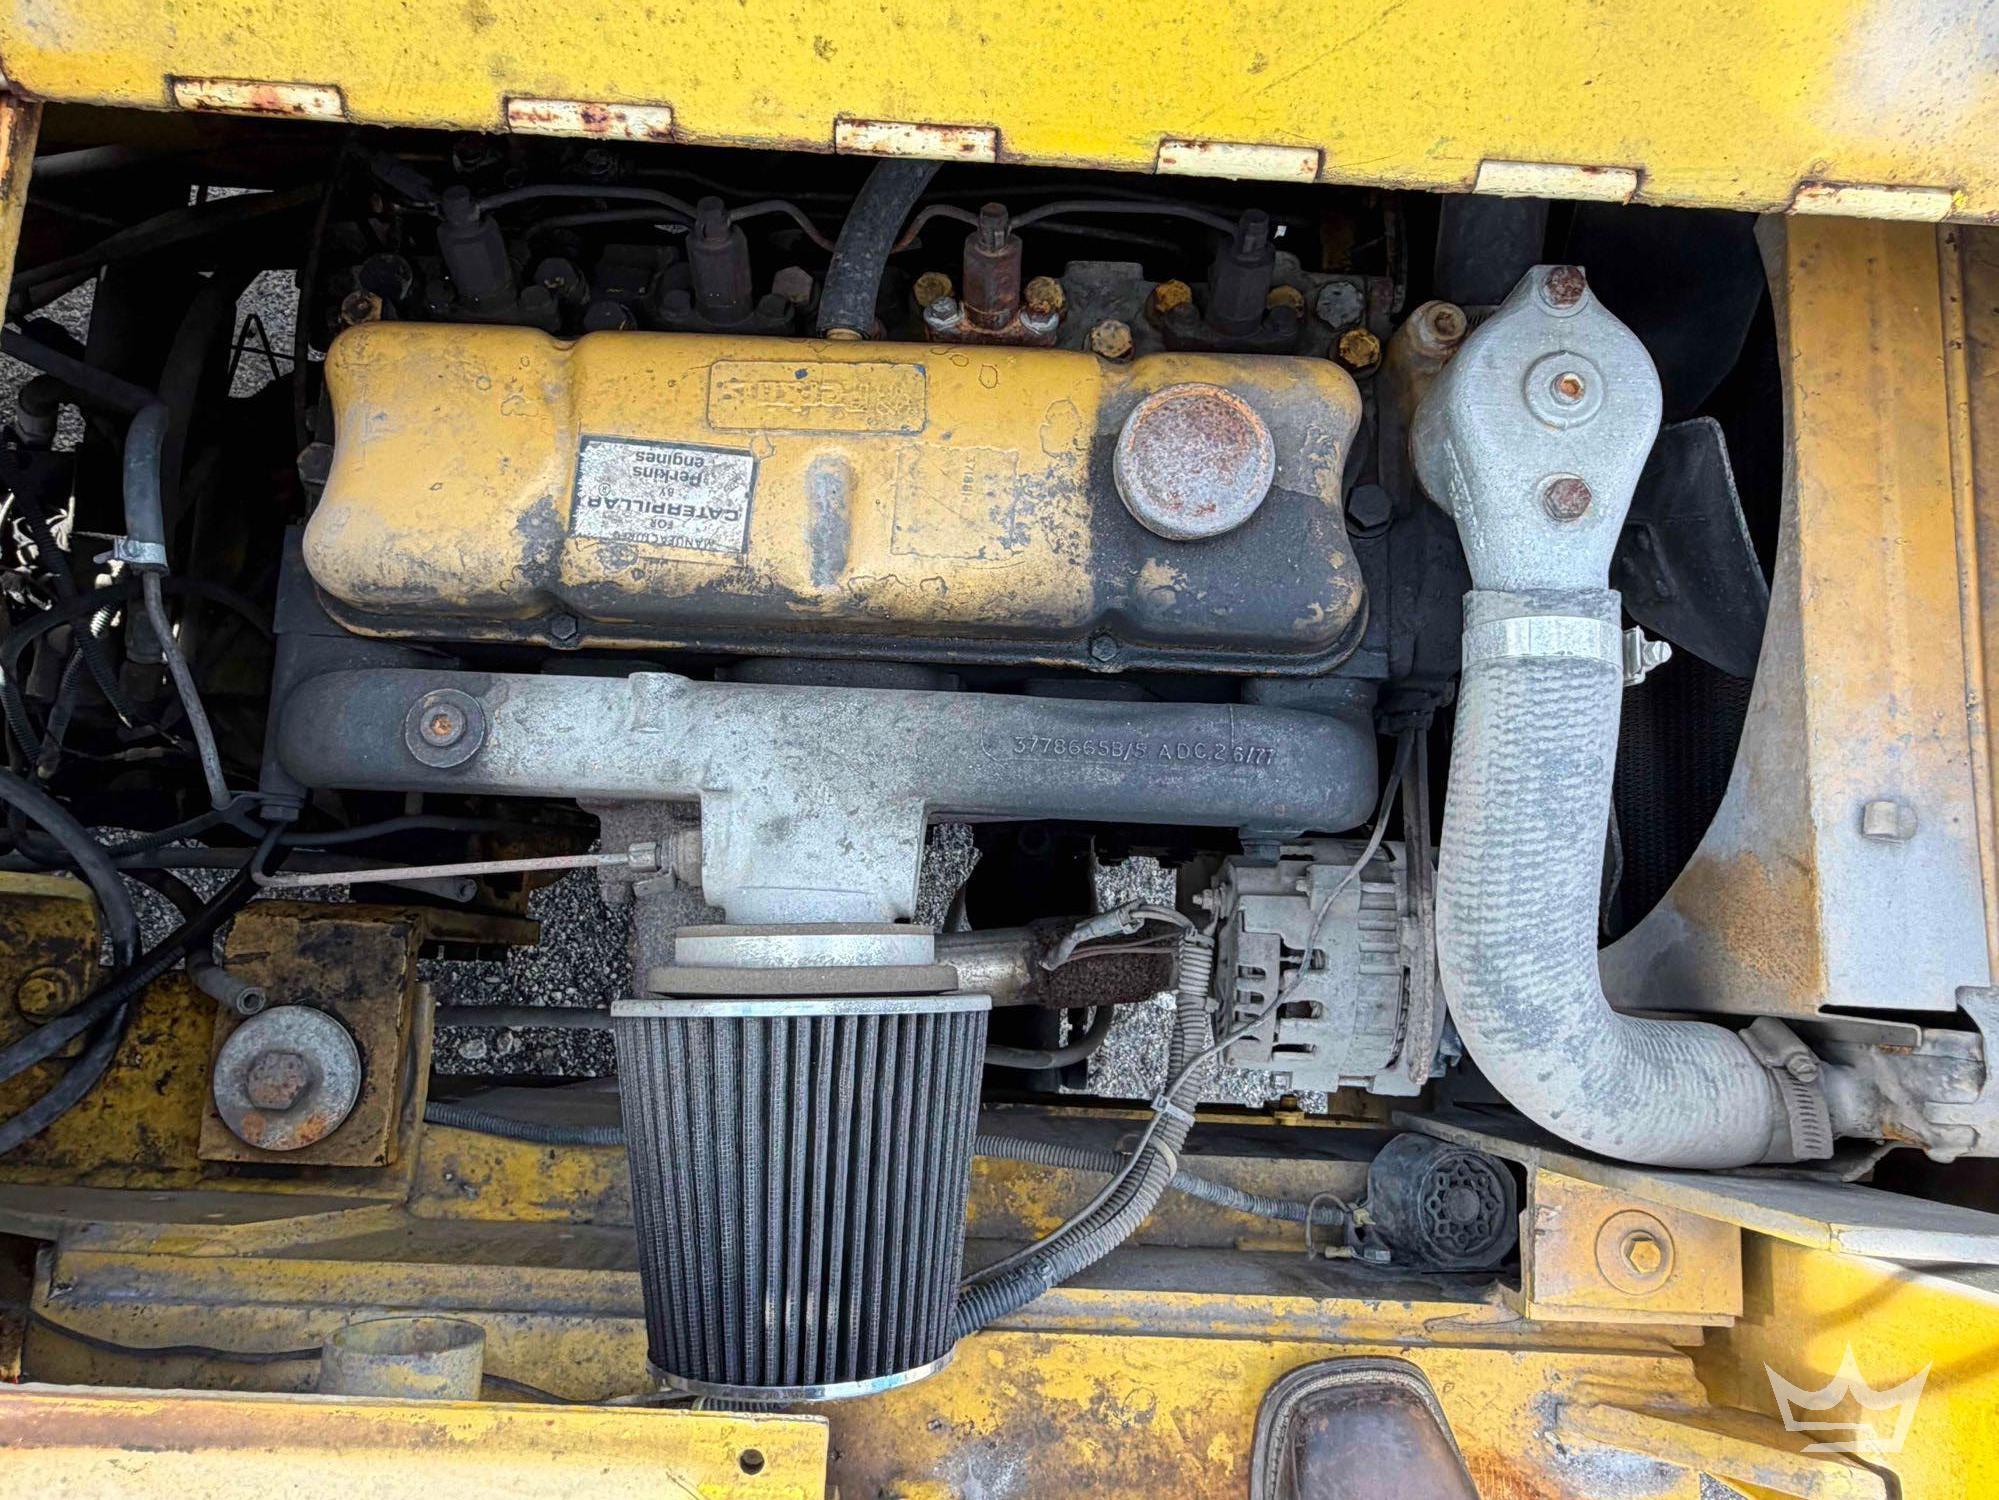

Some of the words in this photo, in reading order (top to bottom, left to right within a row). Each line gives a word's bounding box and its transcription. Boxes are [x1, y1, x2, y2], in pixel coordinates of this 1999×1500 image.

[635, 451, 705, 468] engines
[632, 466, 703, 487] Perkins
[659, 487, 675, 498] BY
[587, 496, 741, 522] CATERPILLAR
[650, 518, 674, 530] FOR
